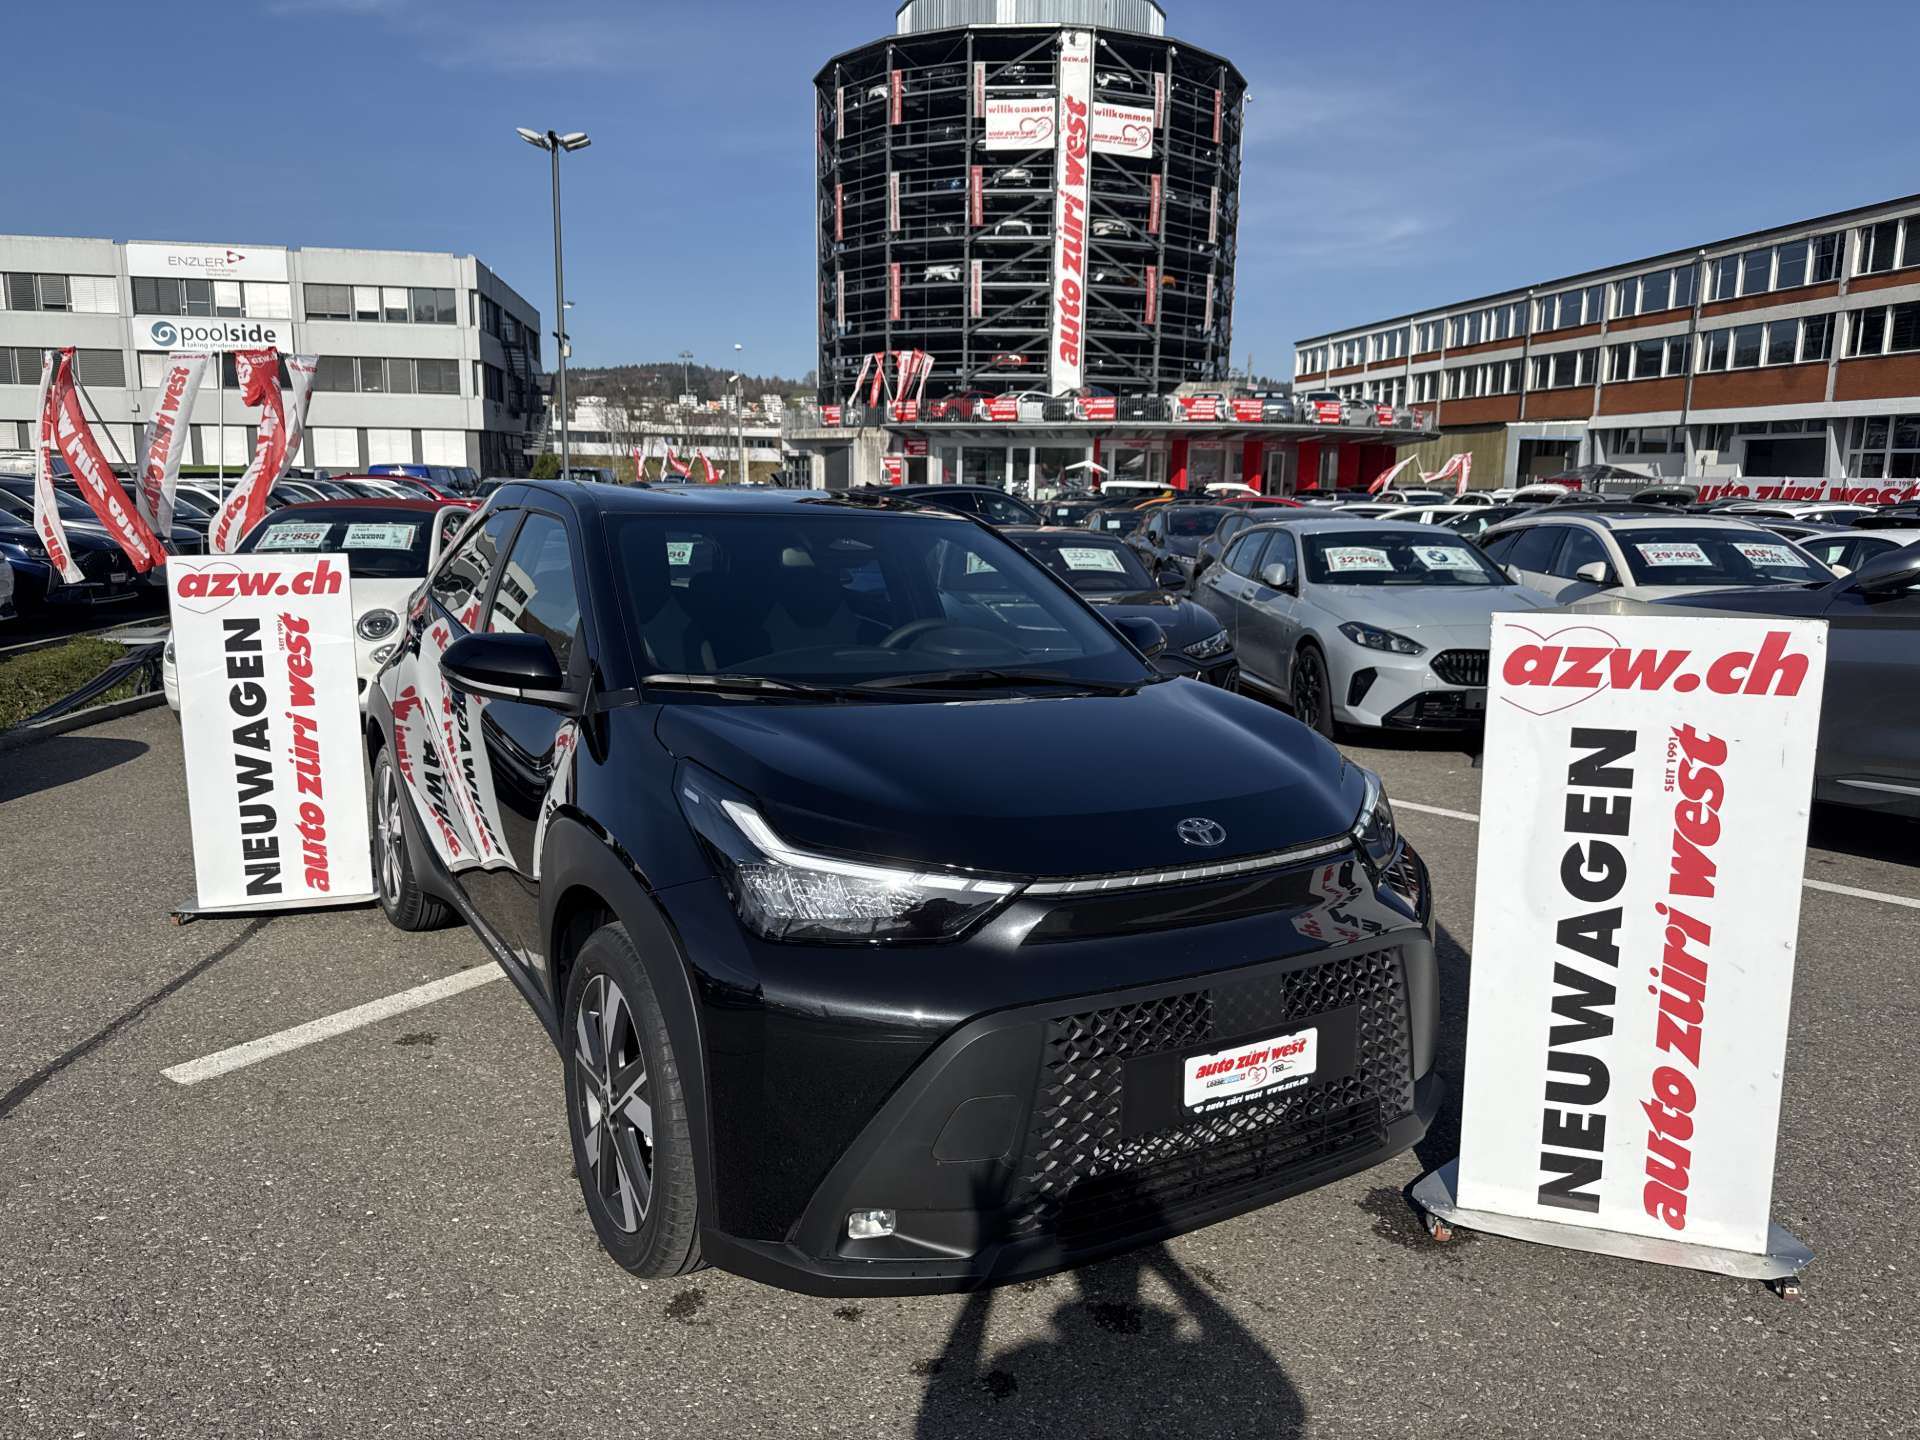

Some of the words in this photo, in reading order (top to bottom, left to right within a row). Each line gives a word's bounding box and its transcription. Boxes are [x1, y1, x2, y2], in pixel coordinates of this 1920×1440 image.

[988, 103, 1053, 114] willkommen
[1094, 109, 1152, 123] willkommen
[1064, 94, 1088, 187] west
[168, 255, 224, 268] ENZLER
[1057, 190, 1085, 278] züri
[181, 323, 276, 347] poolside
[1059, 277, 1081, 367] auto
[161, 366, 190, 412] west
[1695, 480, 1749, 504] uto
[215, 495, 247, 553] auto
[177, 560, 342, 598] azw.ch
[278, 612, 315, 706] west
[1503, 631, 1810, 697] azw.ch
[223, 617, 283, 896] NEUWAGEN
[285, 711, 324, 800] züri
[1664, 768, 1675, 792] SEIT
[1667, 737, 1678, 763] 1991
[1668, 723, 1728, 899] west
[295, 801, 330, 893] auto
[1538, 727, 1638, 1213] NEUWAGEN
[1648, 902, 1712, 1069] züri
[1196, 1057, 1235, 1079] auto
[1235, 1046, 1271, 1070] züri
[1272, 1038, 1307, 1060] west
[1205, 1101, 1224, 1112] auto
[1639, 1065, 1697, 1231] auto
